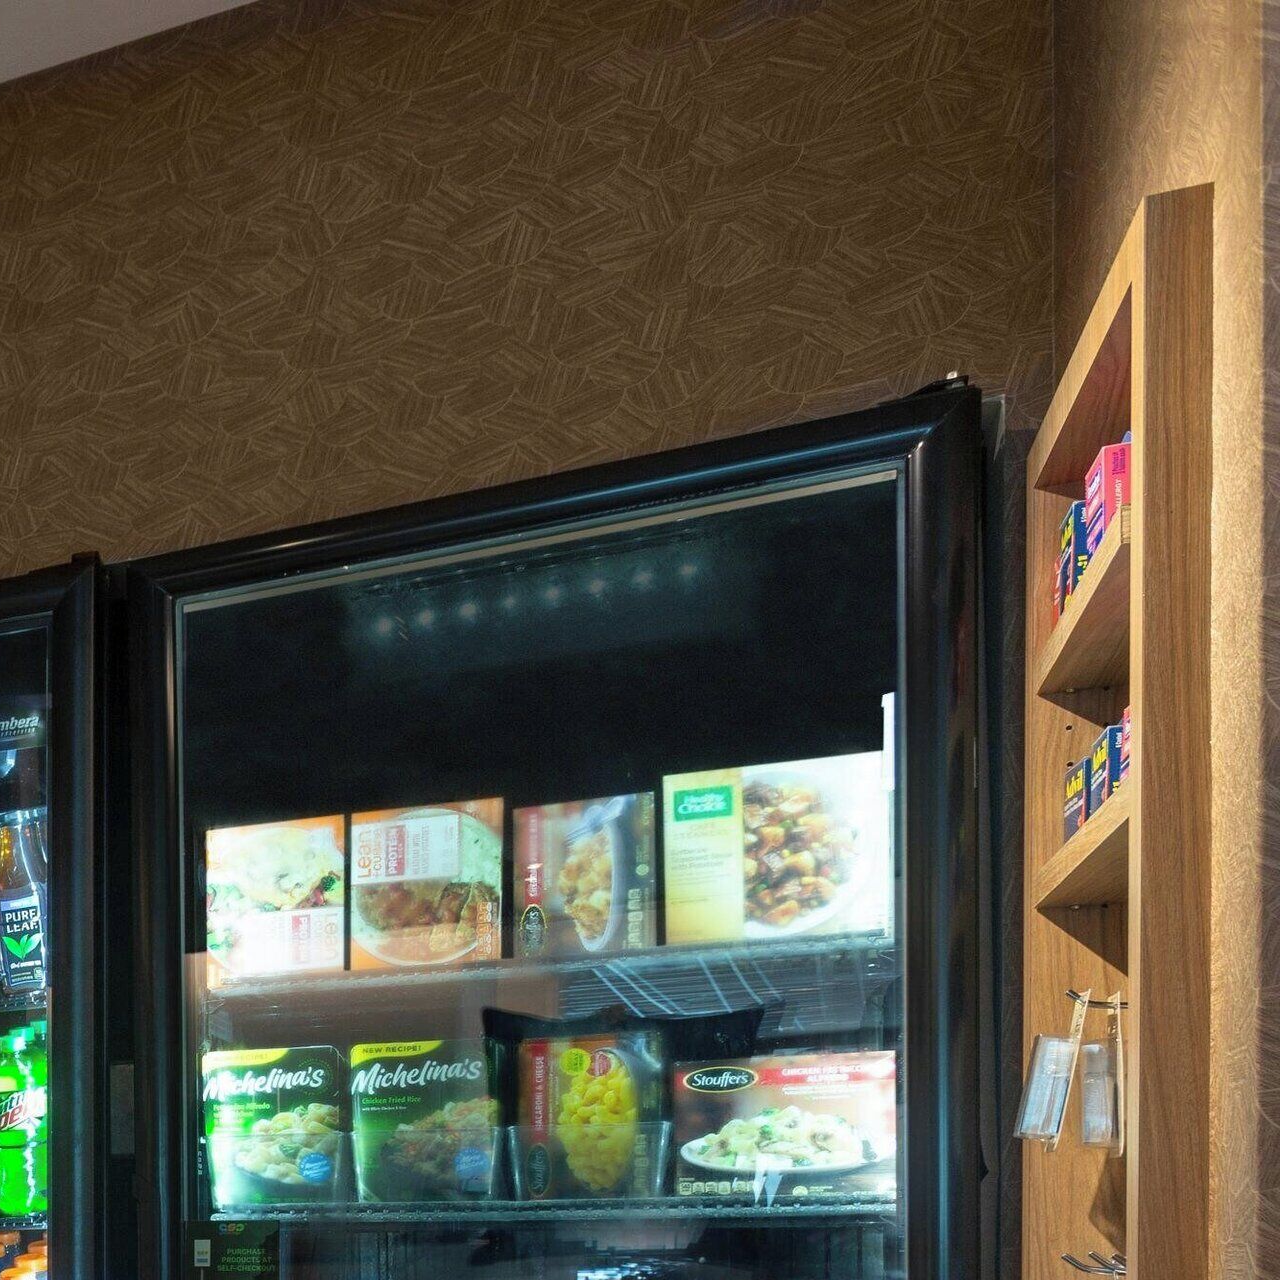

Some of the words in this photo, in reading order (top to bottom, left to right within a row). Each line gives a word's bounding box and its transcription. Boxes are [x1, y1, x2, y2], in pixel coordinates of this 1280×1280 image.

[362, 1046, 382, 1055] NEW
[384, 1044, 422, 1053] RECIPE!
[203, 1066, 325, 1102] Michelina's
[351, 1057, 484, 1096] Michelina's
[692, 1067, 749, 1089] Stouffer's
